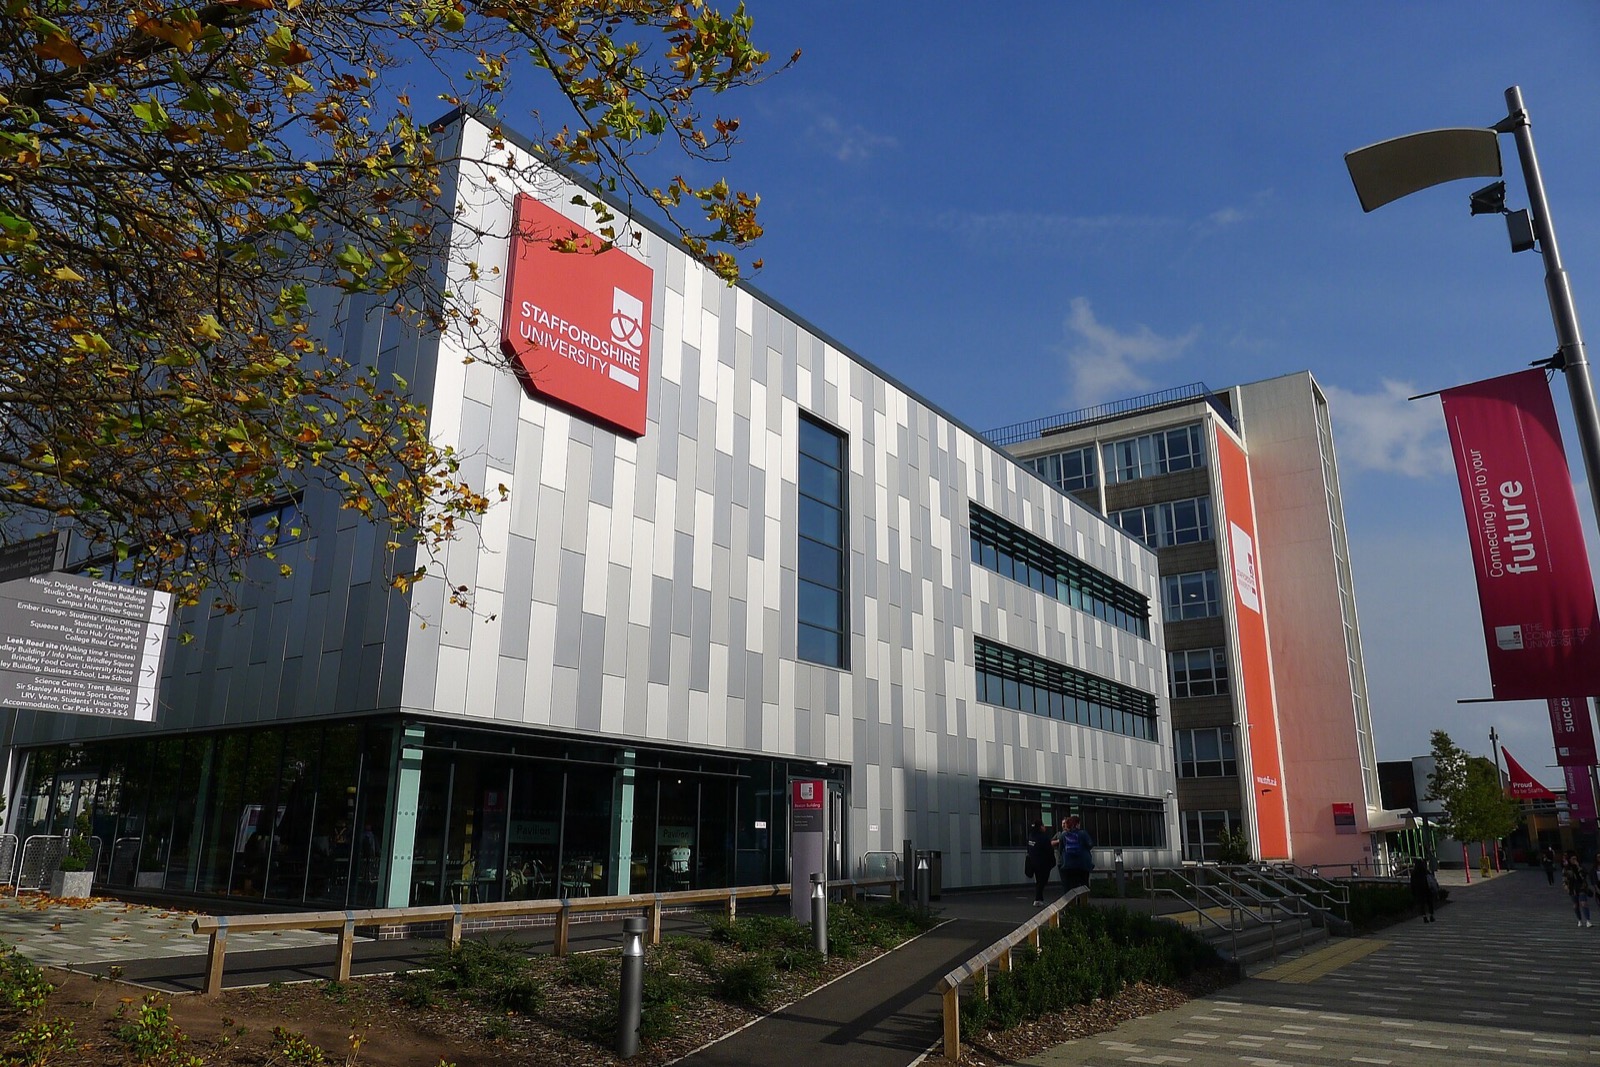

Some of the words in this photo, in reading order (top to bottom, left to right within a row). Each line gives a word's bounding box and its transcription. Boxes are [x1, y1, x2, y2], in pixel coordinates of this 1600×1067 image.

[521, 301, 640, 372] STAFFORDSHIRE
[520, 320, 608, 375] UNIVERSITY
[1470, 449, 1487, 474] your
[1475, 475, 1487, 487] to
[1479, 488, 1494, 510] you
[1500, 480, 1538, 575] future
[1483, 511, 1503, 577] Connecting
[30, 576, 52, 587] Mellor,
[54, 581, 78, 591] Dwight
[118, 592, 146, 604] Buildings
[92, 580, 116, 590] College
[118, 586, 134, 594] Road
[44, 586, 64, 596] Studio
[66, 592, 82, 600] One,
[84, 594, 123, 606] Performance
[124, 602, 144, 610] Centre
[56, 598, 82, 608] Campus
[84, 602, 98, 611] Hub,
[101, 605, 121, 614] Ember
[122, 609, 144, 618] Square
[18, 602, 40, 612] Ember
[42, 606, 68, 617] Lounge,
[69, 610, 100, 621] Students'
[100, 616, 118, 624] Union
[120, 620, 140, 628] Offices
[30, 620, 58, 630] Squeeze
[60, 625, 74, 634] Box,
[90, 630, 102, 638] Hub
[108, 633, 138, 643] GreenPad
[74, 620, 104, 630] Students'
[105, 624, 123, 633] Union
[124, 628, 140, 637] Shop
[1524, 622, 1543, 632] THE
[1524, 627, 1591, 640] CONNECTED
[6, 636, 24, 645] Leek
[26, 638, 44, 648] Road
[60, 644, 88, 656] (Walking
[88, 648, 104, 656] time
[110, 652, 136, 662] minutes)
[66, 634, 90, 644] College
[91, 638, 108, 646] Road
[120, 642, 137, 650] Parks
[1525, 637, 1586, 648] UNIVERSITY
[12, 653, 40, 664] Brindley
[40, 658, 58, 666] Food
[60, 660, 80, 669] Court,
[82, 663, 112, 674] University
[114, 668, 134, 676] House
[18, 646, 46, 657] Building
[52, 651, 64, 659] Info
[66, 652, 84, 662] Point,
[86, 656, 112, 666] Brindley
[113, 660, 134, 668] Square
[12, 662, 42, 672] Building,
[44, 666, 72, 675] Business
[73, 670, 96, 679] School,
[112, 674, 132, 682] School
[26, 684, 52, 694] Stanley
[53, 687, 86, 696] Matthews
[86, 690, 108, 699] Sports
[108, 693, 130, 701] Centre
[34, 676, 60, 686] Science
[62, 680, 86, 690] Centre,
[106, 685, 130, 695] Building
[2, 698, 60, 711] Accommodation,
[38, 694, 60, 702] Verve,
[61, 696, 92, 704] Students'
[112, 702, 128, 710] Shop
